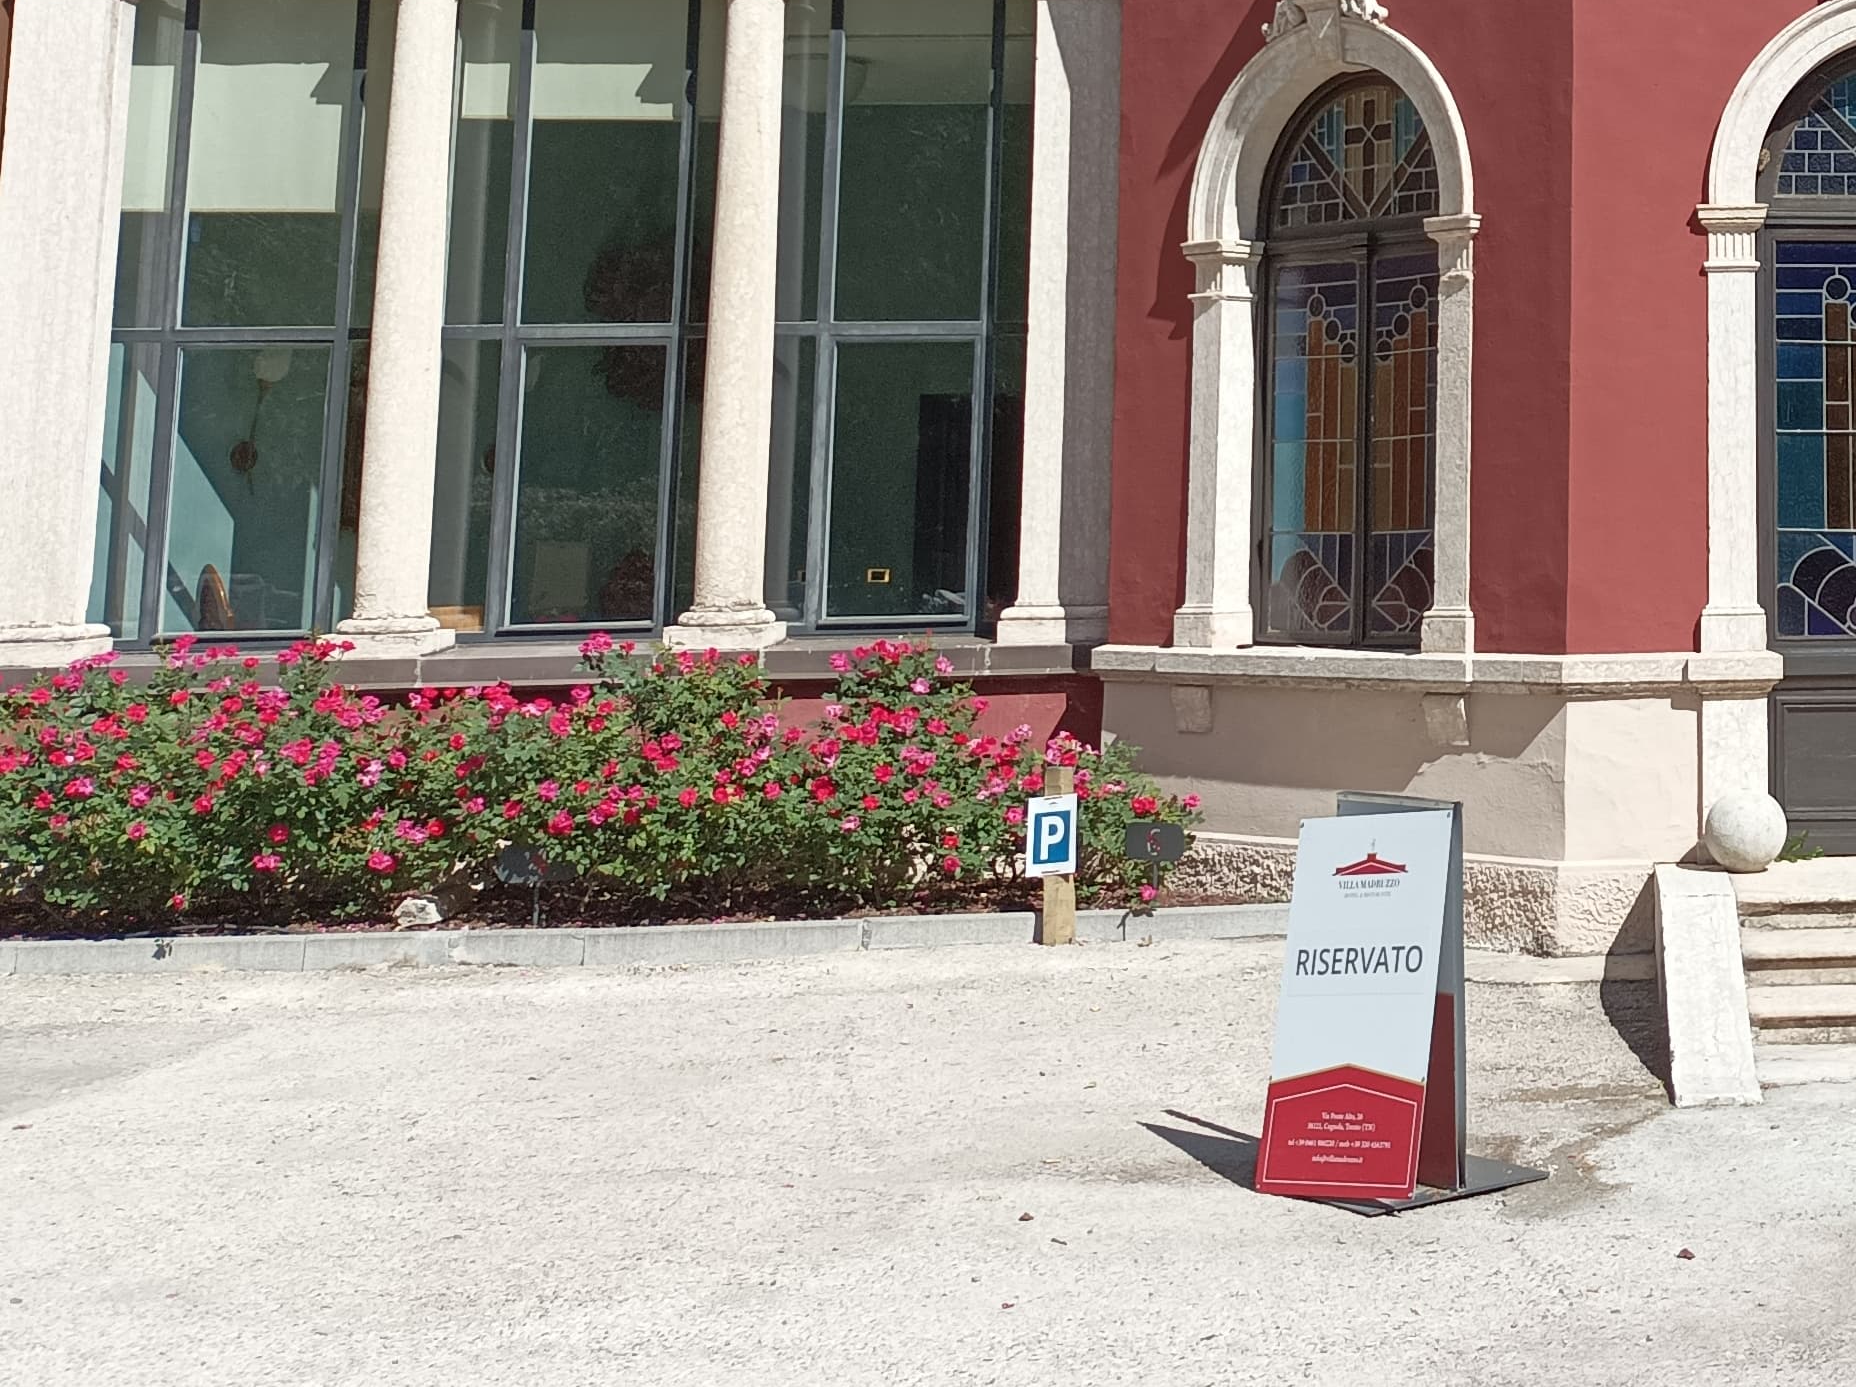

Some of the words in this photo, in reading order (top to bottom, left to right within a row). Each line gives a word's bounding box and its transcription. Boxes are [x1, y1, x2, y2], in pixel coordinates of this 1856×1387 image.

[1039, 815, 1065, 861] P
[1338, 879, 1359, 890] VILLA
[1360, 878, 1400, 889] MADRUZZO
[1295, 944, 1424, 977] RISERVATO
